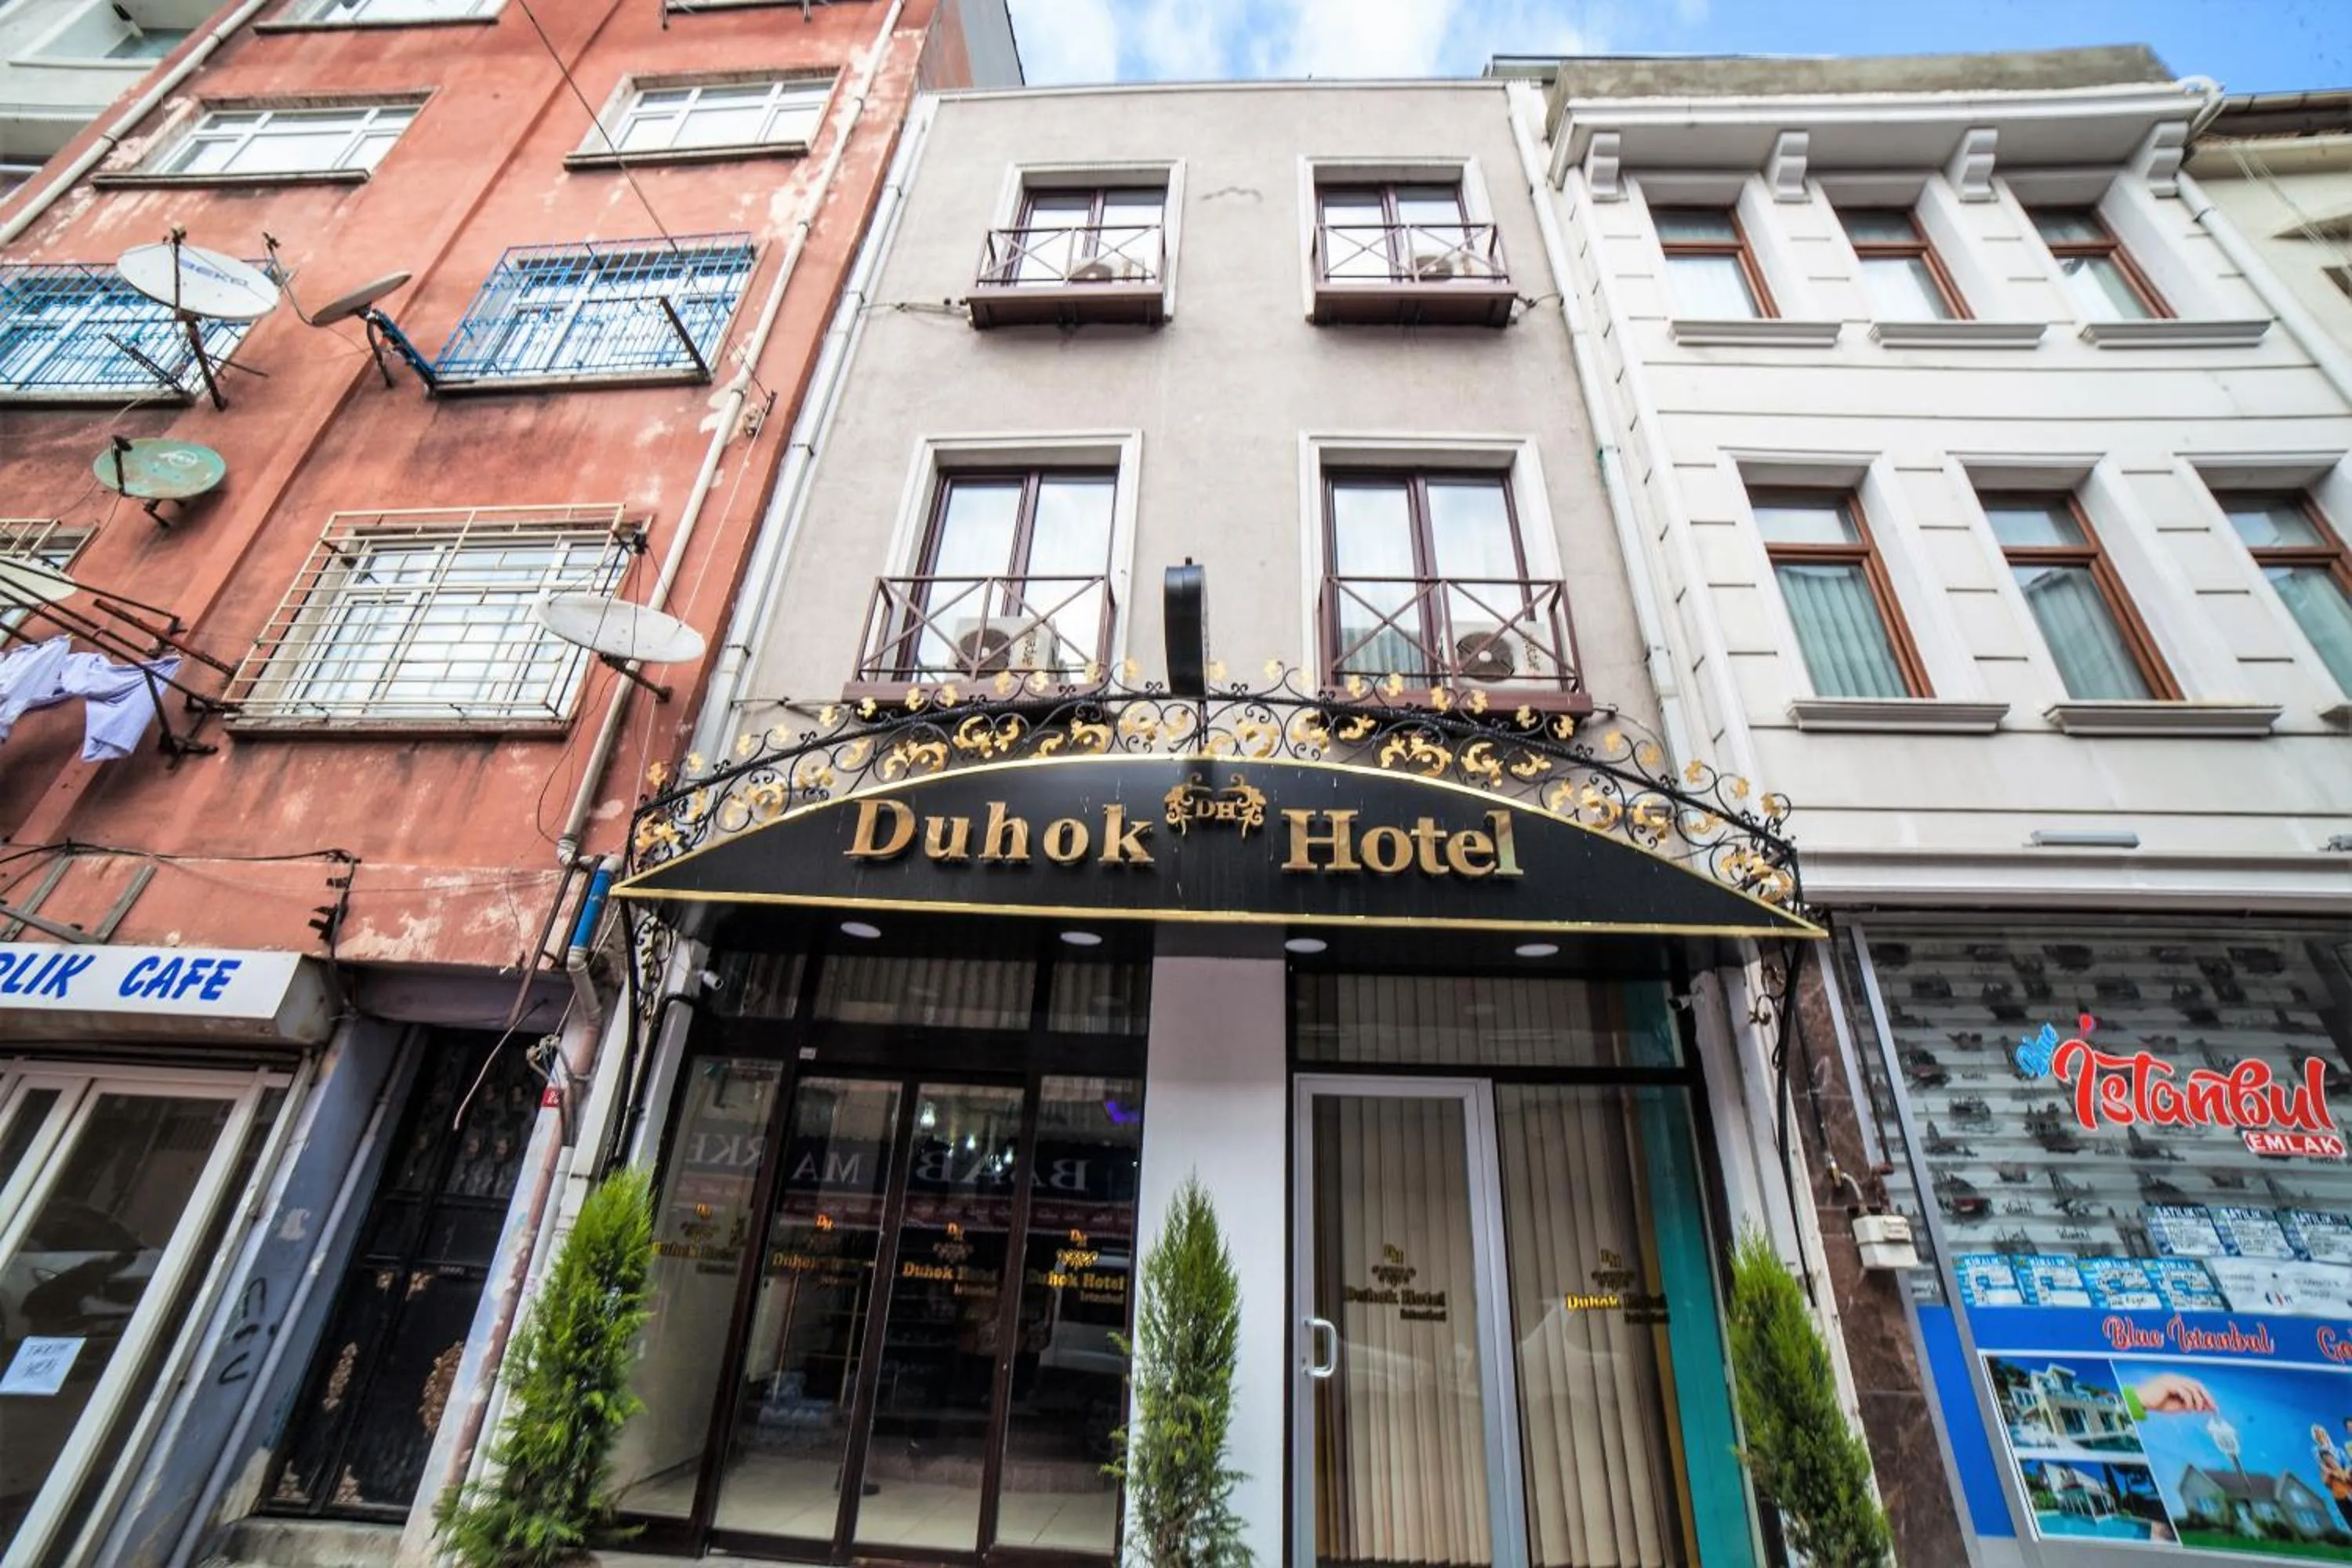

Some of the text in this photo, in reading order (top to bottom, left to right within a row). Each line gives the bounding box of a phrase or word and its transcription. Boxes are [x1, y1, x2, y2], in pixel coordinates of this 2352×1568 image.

[1196, 799, 1238, 820] DH
[844, 798, 1525, 877] Duhok Hotel
[118, 955, 242, 1000] CAFE
[2249, 1134, 2339, 1155] EMLAK
[902, 1261, 953, 1280] Duhok
[1082, 1272, 1125, 1293] Hotel
[1566, 1292, 1621, 1311] Duhok
[2103, 1315, 2165, 1351] Blue
